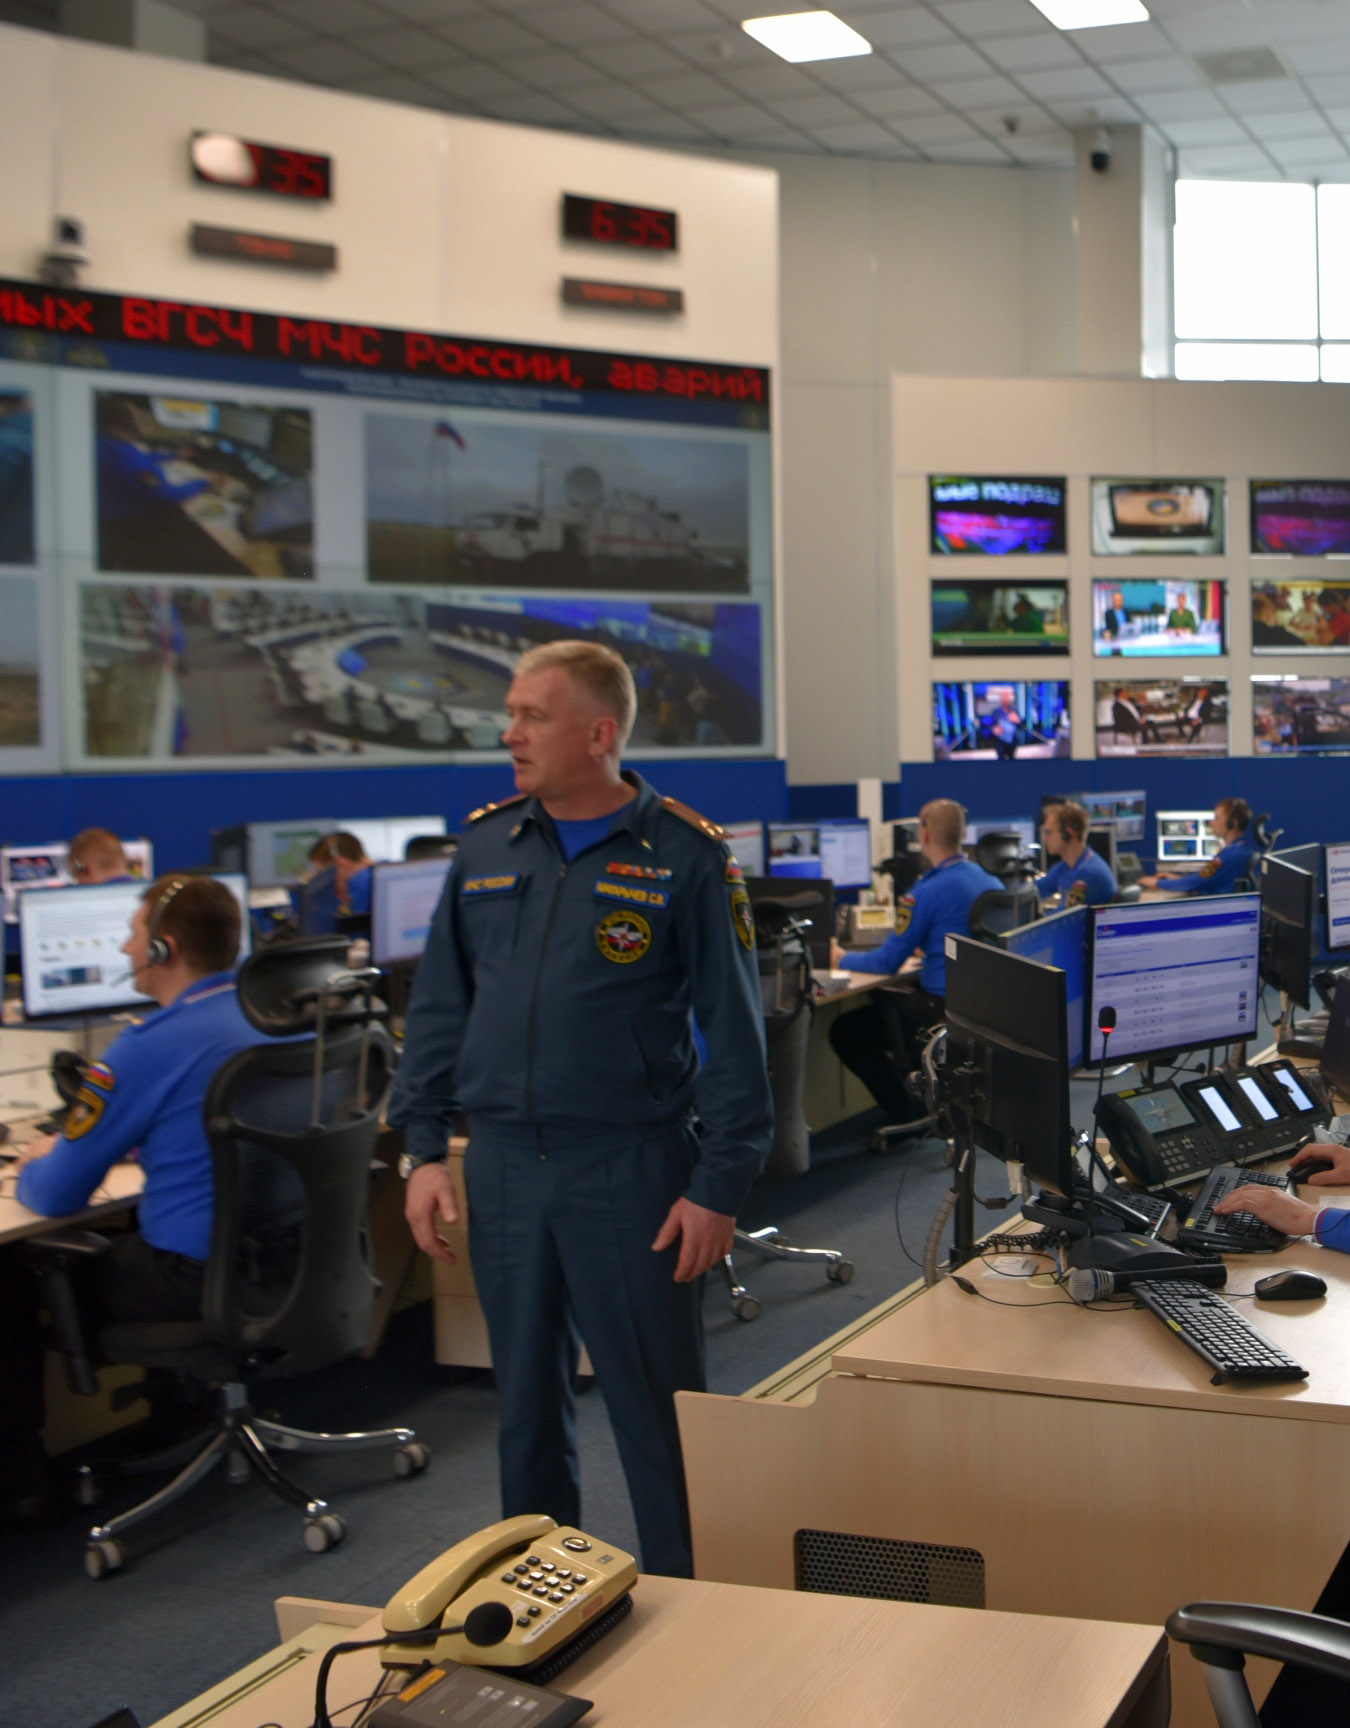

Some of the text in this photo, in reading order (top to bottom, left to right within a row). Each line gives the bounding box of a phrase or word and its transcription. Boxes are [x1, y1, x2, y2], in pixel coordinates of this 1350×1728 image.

[591, 201, 671, 249] 6:35
[121, 295, 253, 351] ВГСЧ
[276, 316, 382, 366] МЧС
[404, 331, 585, 389] России,
[606, 360, 763, 402] аварий
